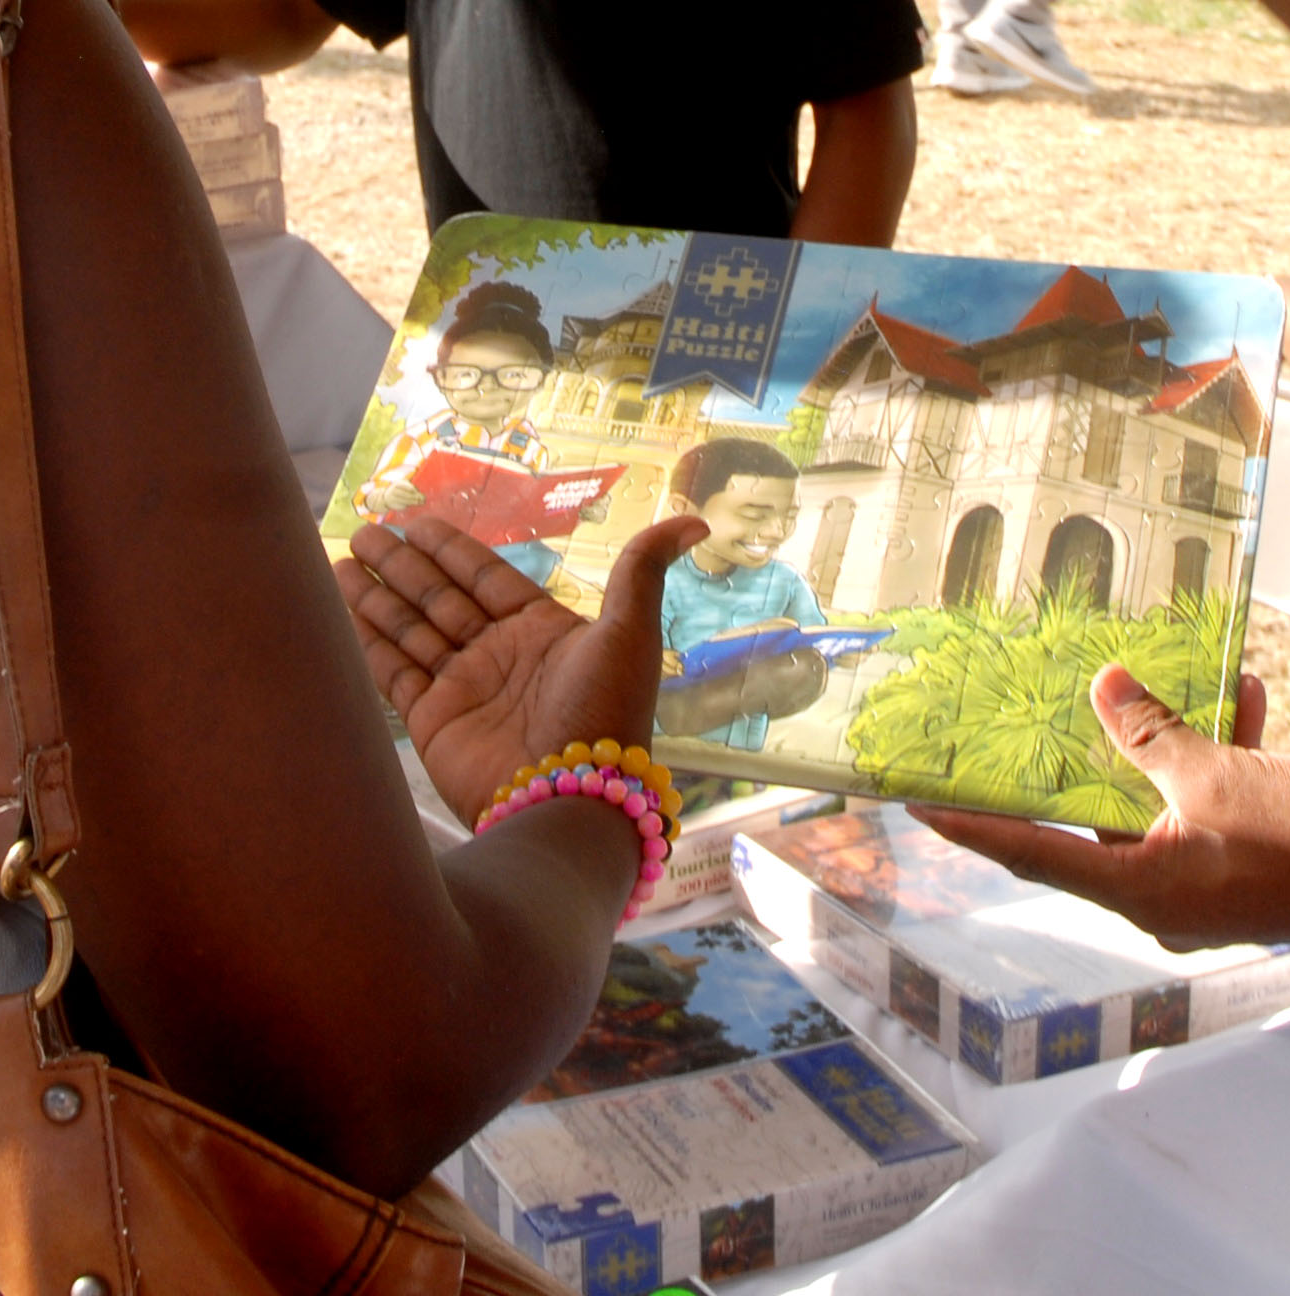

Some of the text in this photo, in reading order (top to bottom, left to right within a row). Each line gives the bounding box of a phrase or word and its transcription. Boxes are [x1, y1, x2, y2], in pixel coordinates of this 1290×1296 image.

[671, 316, 766, 343] Haiti
[666, 337, 760, 361] Puzzle
[669, 853, 732, 880] Tourism
